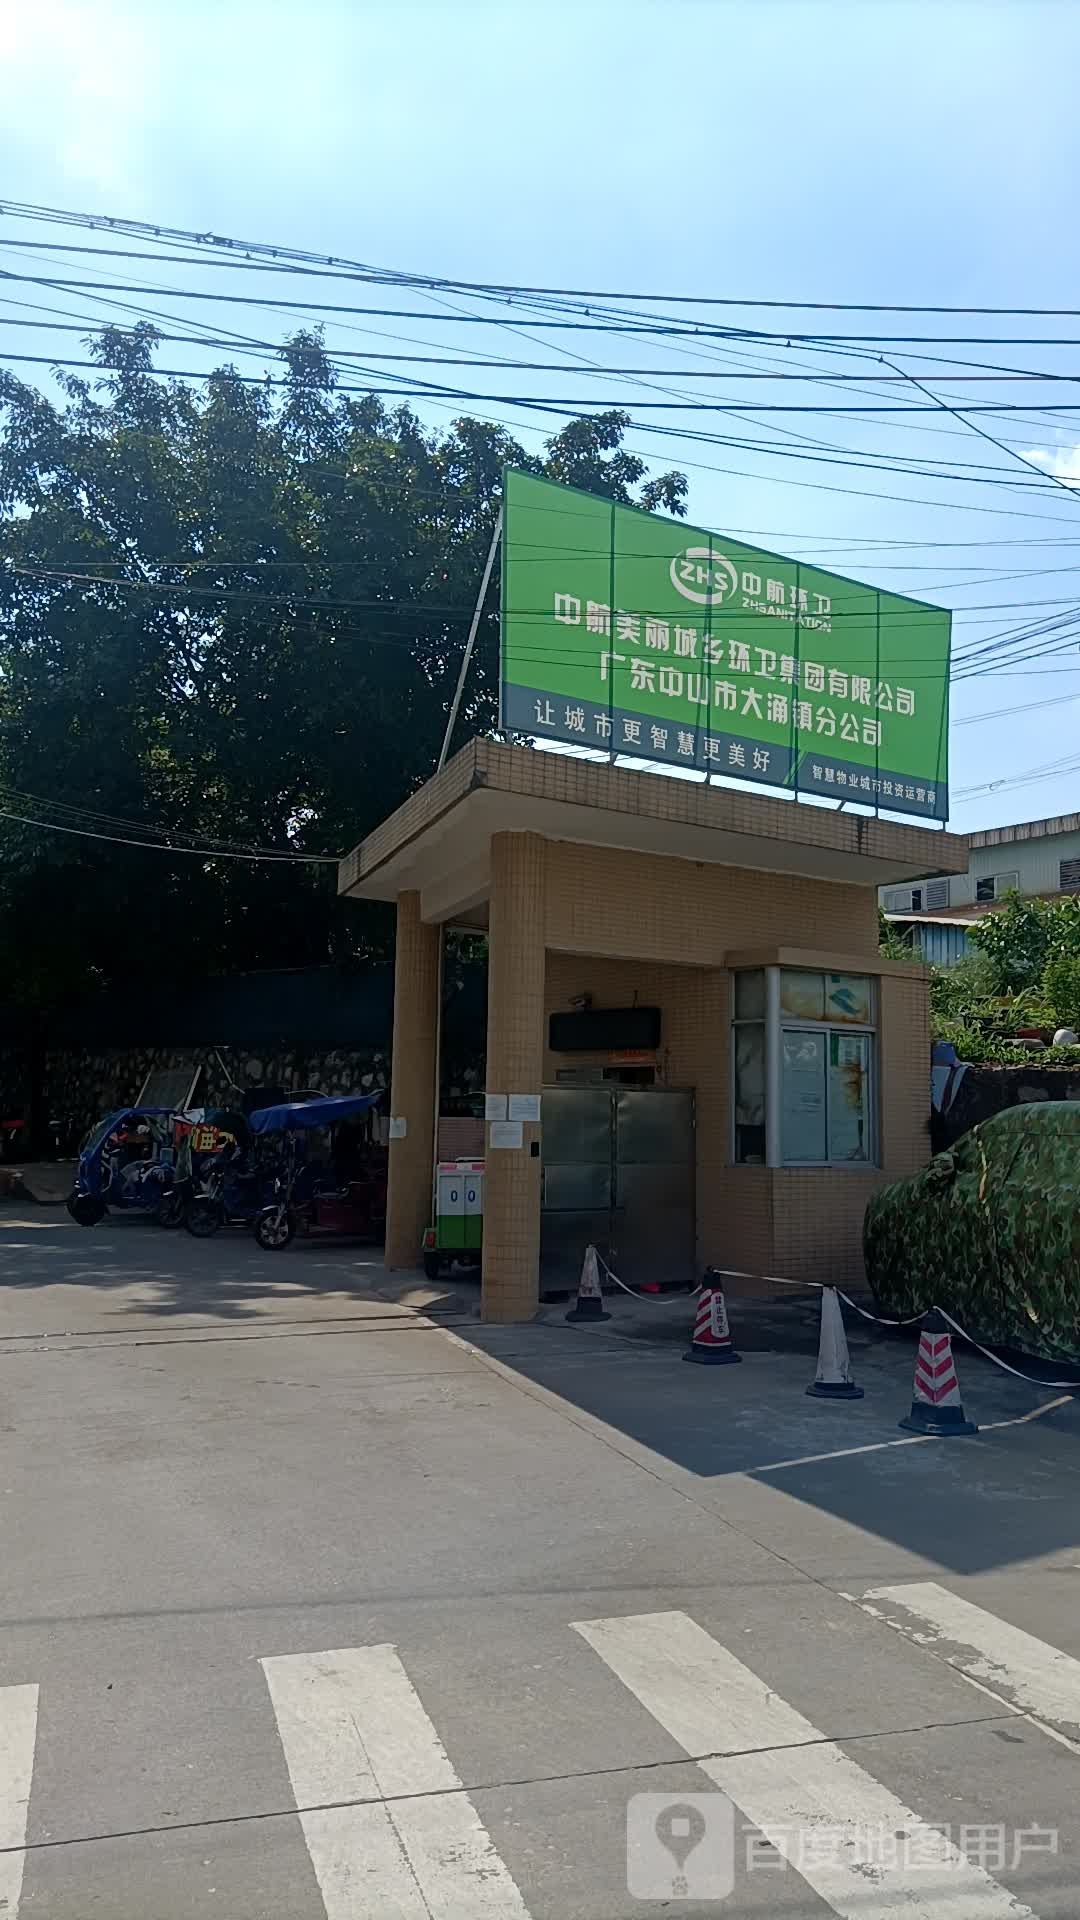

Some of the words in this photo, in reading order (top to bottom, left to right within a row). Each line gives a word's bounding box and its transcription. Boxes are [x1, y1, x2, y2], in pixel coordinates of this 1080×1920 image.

[679, 560, 729, 591] ZHS
[741, 571, 832, 619] 中航环卫
[554, 592, 915, 717] 中航美丽城乡环卫集团有限公司
[600, 650, 882, 747] 广东中山市大涌镇分公司
[533, 699, 770, 773] 让城市更智慧更美好
